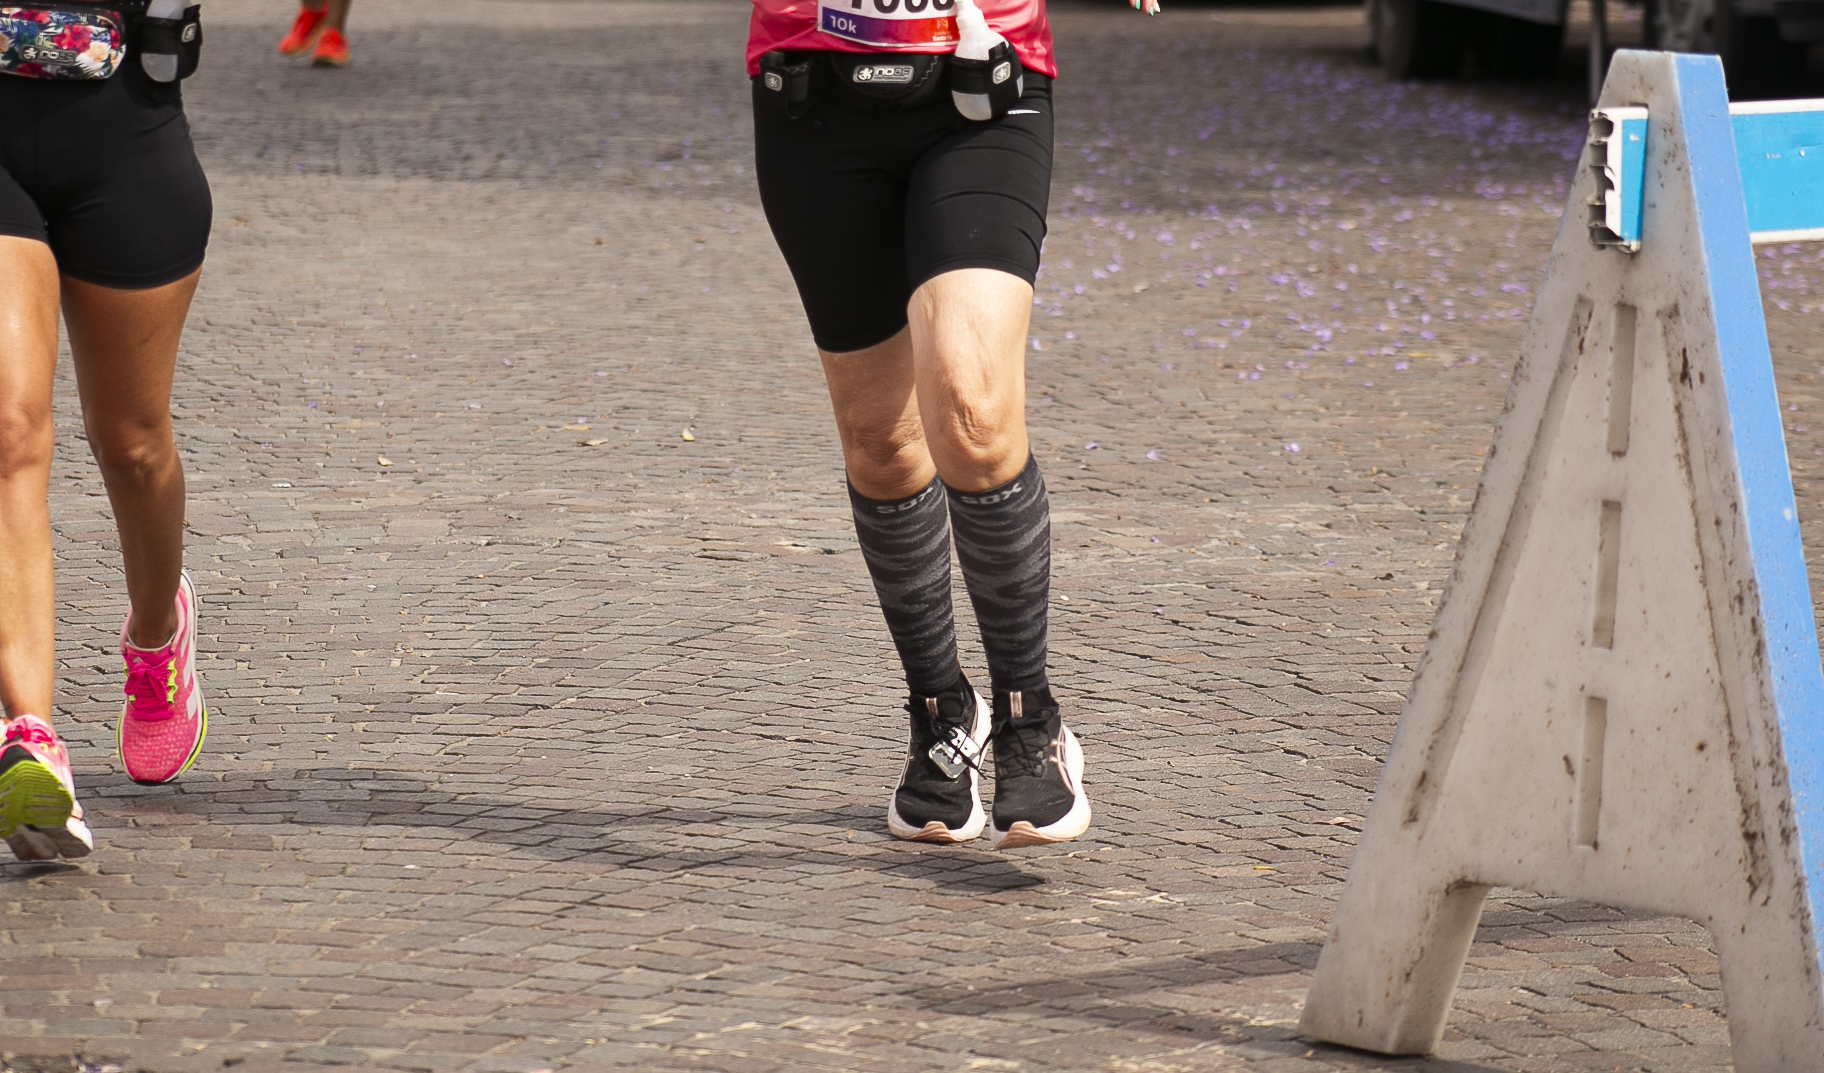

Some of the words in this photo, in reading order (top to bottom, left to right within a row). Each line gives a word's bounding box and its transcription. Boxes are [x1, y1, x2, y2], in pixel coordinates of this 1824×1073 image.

[830, 15, 857, 34] 10k
[876, 486, 933, 514] SOX
[960, 482, 1023, 505] SOX
